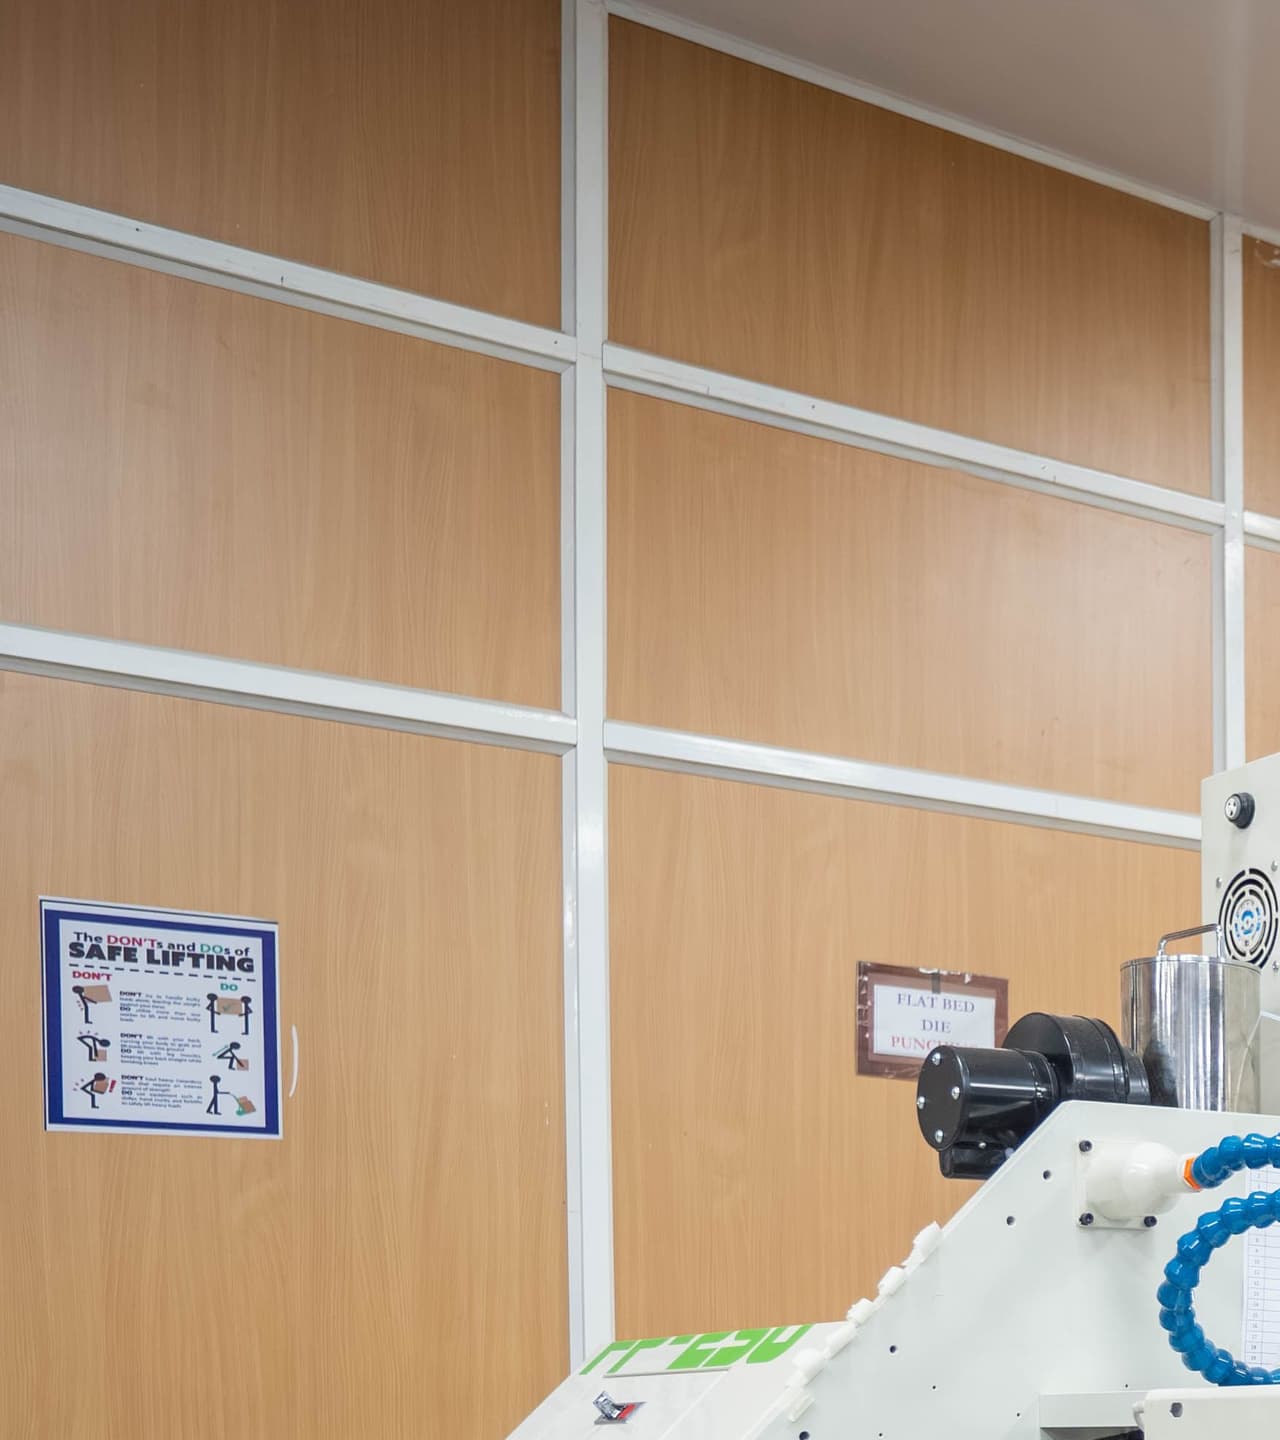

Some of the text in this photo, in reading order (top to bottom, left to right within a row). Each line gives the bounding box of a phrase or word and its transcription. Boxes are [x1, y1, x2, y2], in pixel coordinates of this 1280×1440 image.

[73, 931, 250, 957] The DON'Ts and DOs of
[68, 942, 254, 973] SAFE LIFTING
[72, 971, 113, 981] DON'T
[220, 983, 238, 991] DO
[897, 993, 975, 1013] FLAT BED
[921, 1019, 951, 1033] DIE
